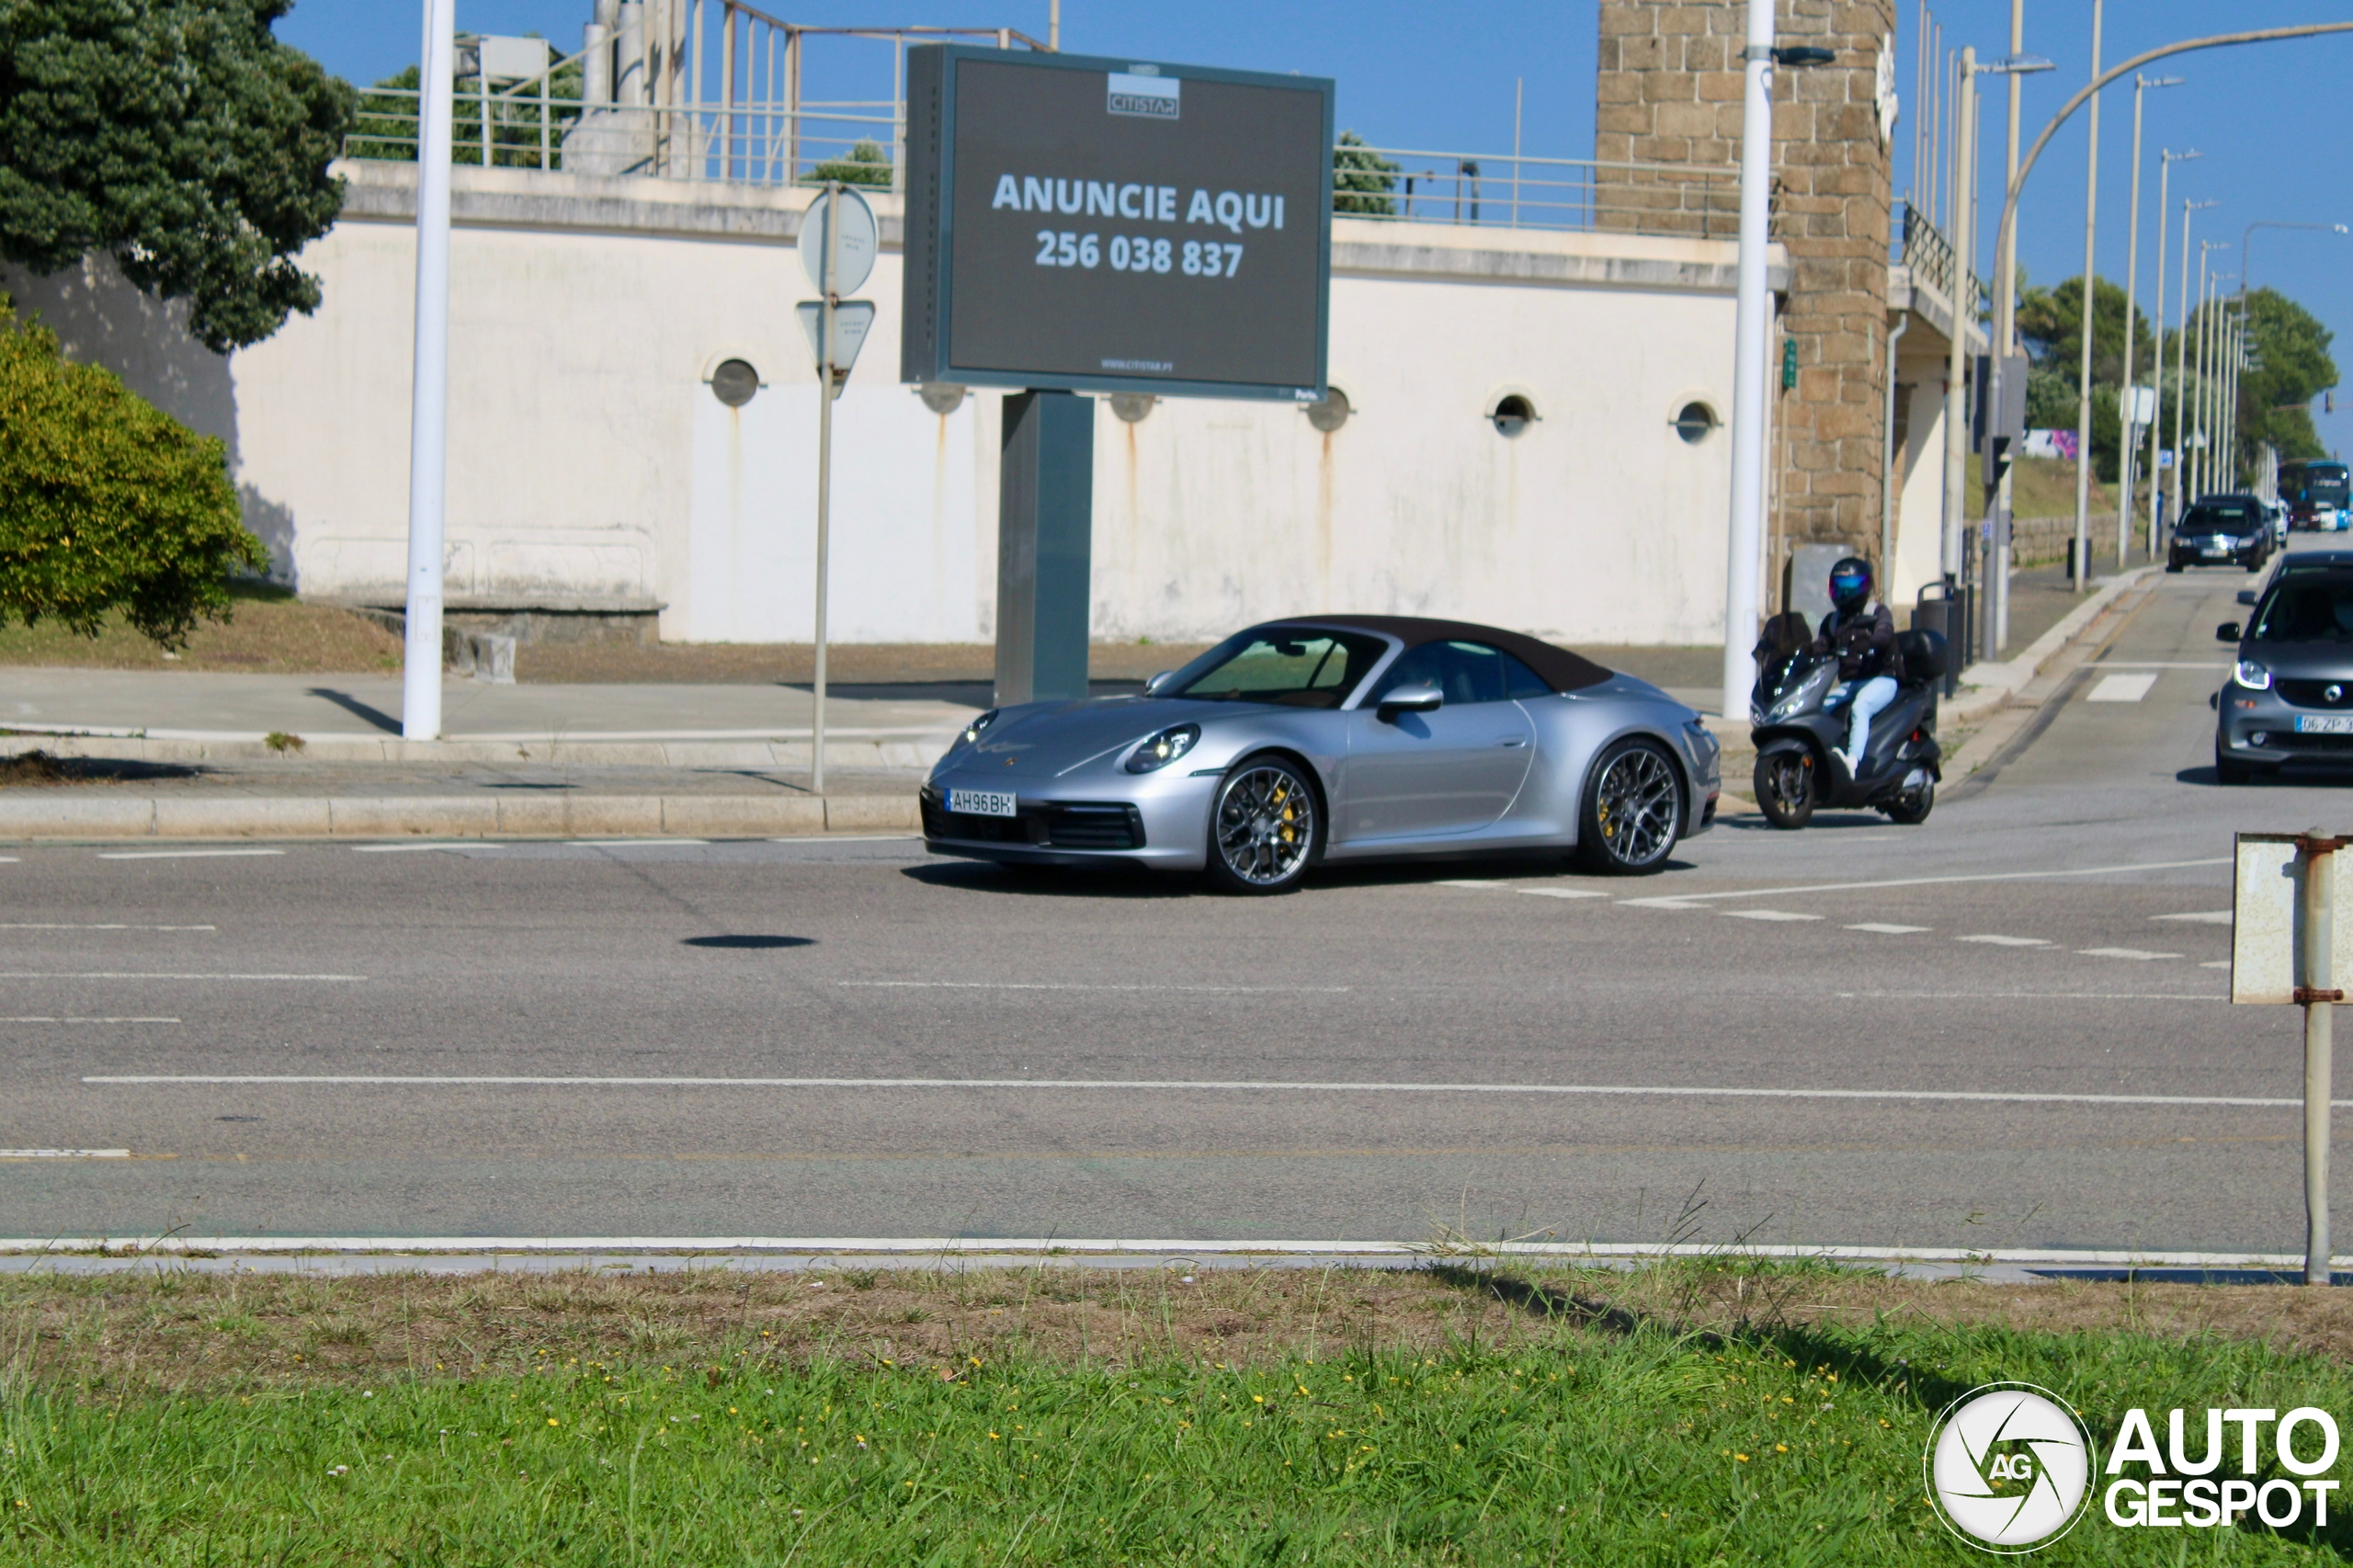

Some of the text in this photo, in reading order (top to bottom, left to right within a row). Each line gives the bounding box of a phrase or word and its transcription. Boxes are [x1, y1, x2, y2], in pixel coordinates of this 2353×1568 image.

[1111, 95, 1176, 115] CITISTAR
[992, 174, 1285, 233] ANUNCIE AQUI
[1035, 230, 1244, 278] 256 038 837
